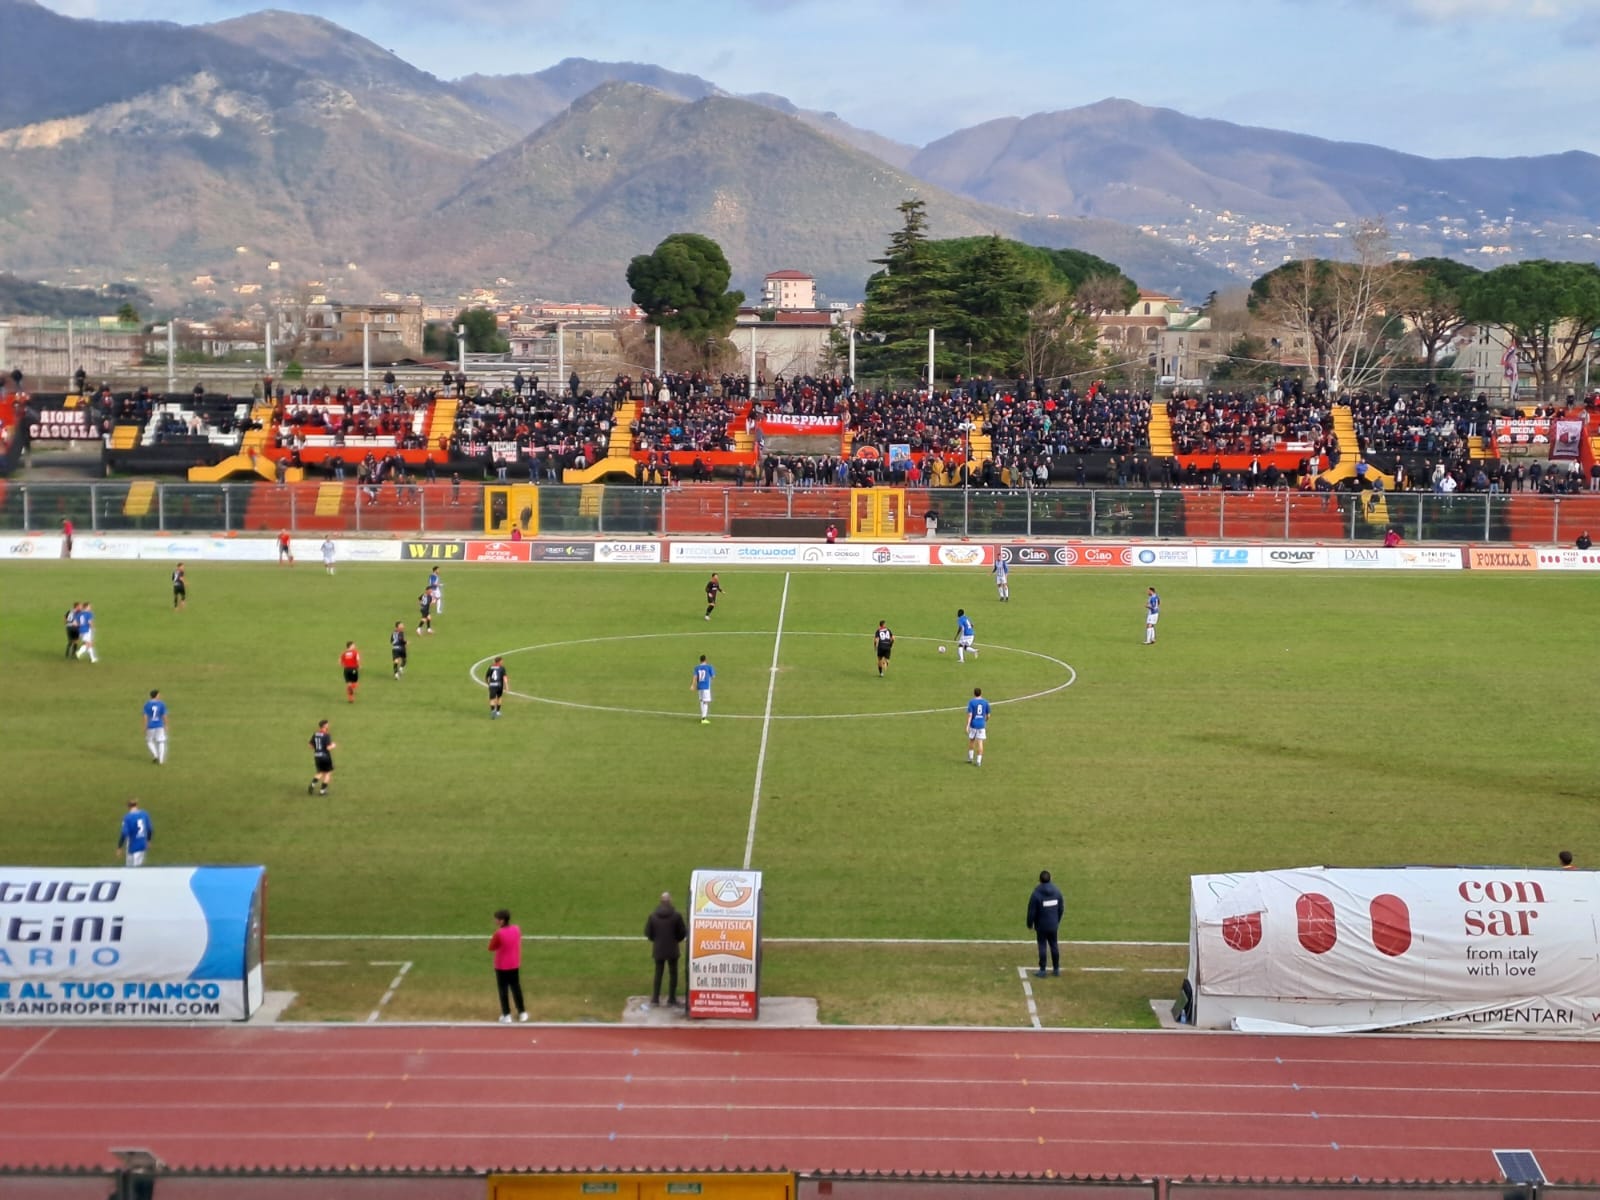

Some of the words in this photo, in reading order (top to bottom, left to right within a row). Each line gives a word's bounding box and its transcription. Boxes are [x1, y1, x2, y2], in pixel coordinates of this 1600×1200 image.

[40, 411, 84, 423] RIONE
[766, 413, 839, 426] INCEPPATI
[29, 424, 99, 438] CASOLLA
[408, 544, 459, 558] WIP
[737, 547, 796, 556] starwood
[1019, 548, 1047, 560] Ciao
[1085, 549, 1113, 561] Ciao
[1270, 551, 1315, 560] COMAT
[1476, 552, 1532, 567] POMILIA
[879, 630, 890, 640] 94
[491, 670, 498, 681] 4
[1458, 880, 1548, 903] con
[694, 919, 752, 930] IMPIANTISTICA
[1464, 909, 1539, 937] sar
[700, 940, 746, 951] ASSISTENZA
[1466, 945, 1503, 960] from
[1508, 945, 1539, 964] italy
[1467, 962, 1500, 976] with
[1505, 962, 1536, 976] love
[19, 983, 52, 999] AL
[60, 983, 115, 999] TUO
[123, 983, 220, 1000] FIANCO
[0, 1002, 220, 1015] SANDROPERTINI.COM
